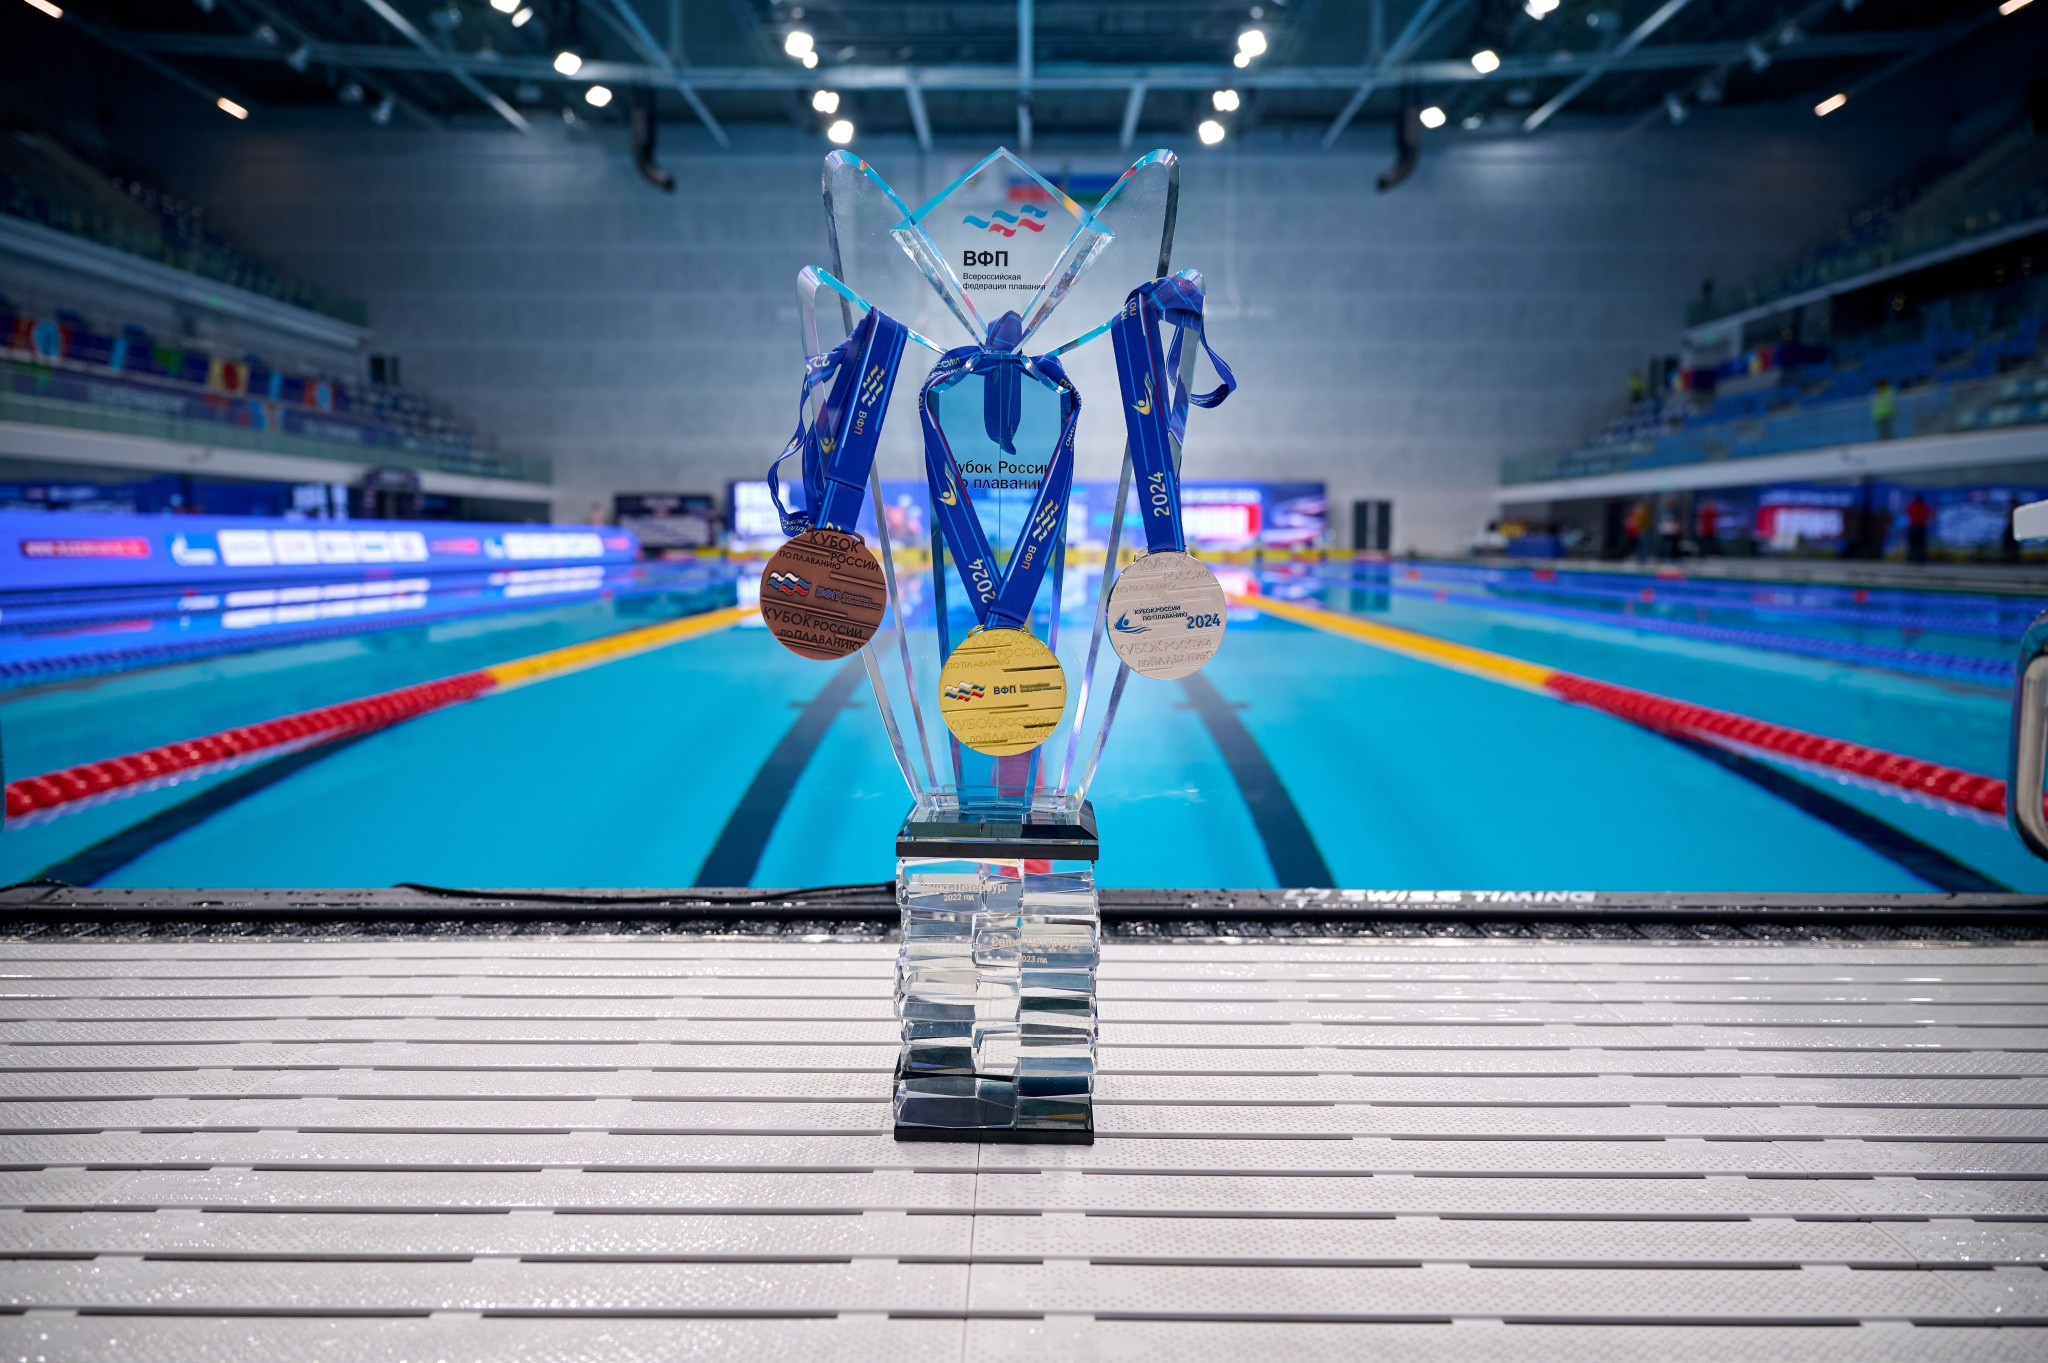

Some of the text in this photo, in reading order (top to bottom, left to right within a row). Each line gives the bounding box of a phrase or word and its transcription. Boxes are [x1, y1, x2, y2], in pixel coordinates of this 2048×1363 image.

[963, 250, 1009, 267] ВФП
[963, 272, 1021, 281] Всероссийская
[962, 282, 1046, 291] федерация плавания
[853, 409, 868, 436] ВФП
[955, 460, 993, 476] убок
[1148, 471, 1171, 518] 2024
[810, 530, 861, 554] КУБОК
[779, 550, 841, 570] ПО ПЛАВАНИЮ
[830, 551, 880, 572] РОССИИ
[1020, 544, 1037, 570] ВФП
[968, 558, 996, 604] 2024
[1134, 605, 1181, 615] КУБОК РОССИИ
[1153, 611, 1188, 620] ПЛАВАНИЮ
[763, 606, 863, 638] КУБОК РОССИИ
[1186, 612, 1221, 630] 2024
[794, 629, 861, 652] ПЛАВАНИЮ
[993, 684, 1017, 695] ВФП
[943, 894, 975, 902] 2022 год
[1338, 889, 1597, 903] SWISS TIMING
